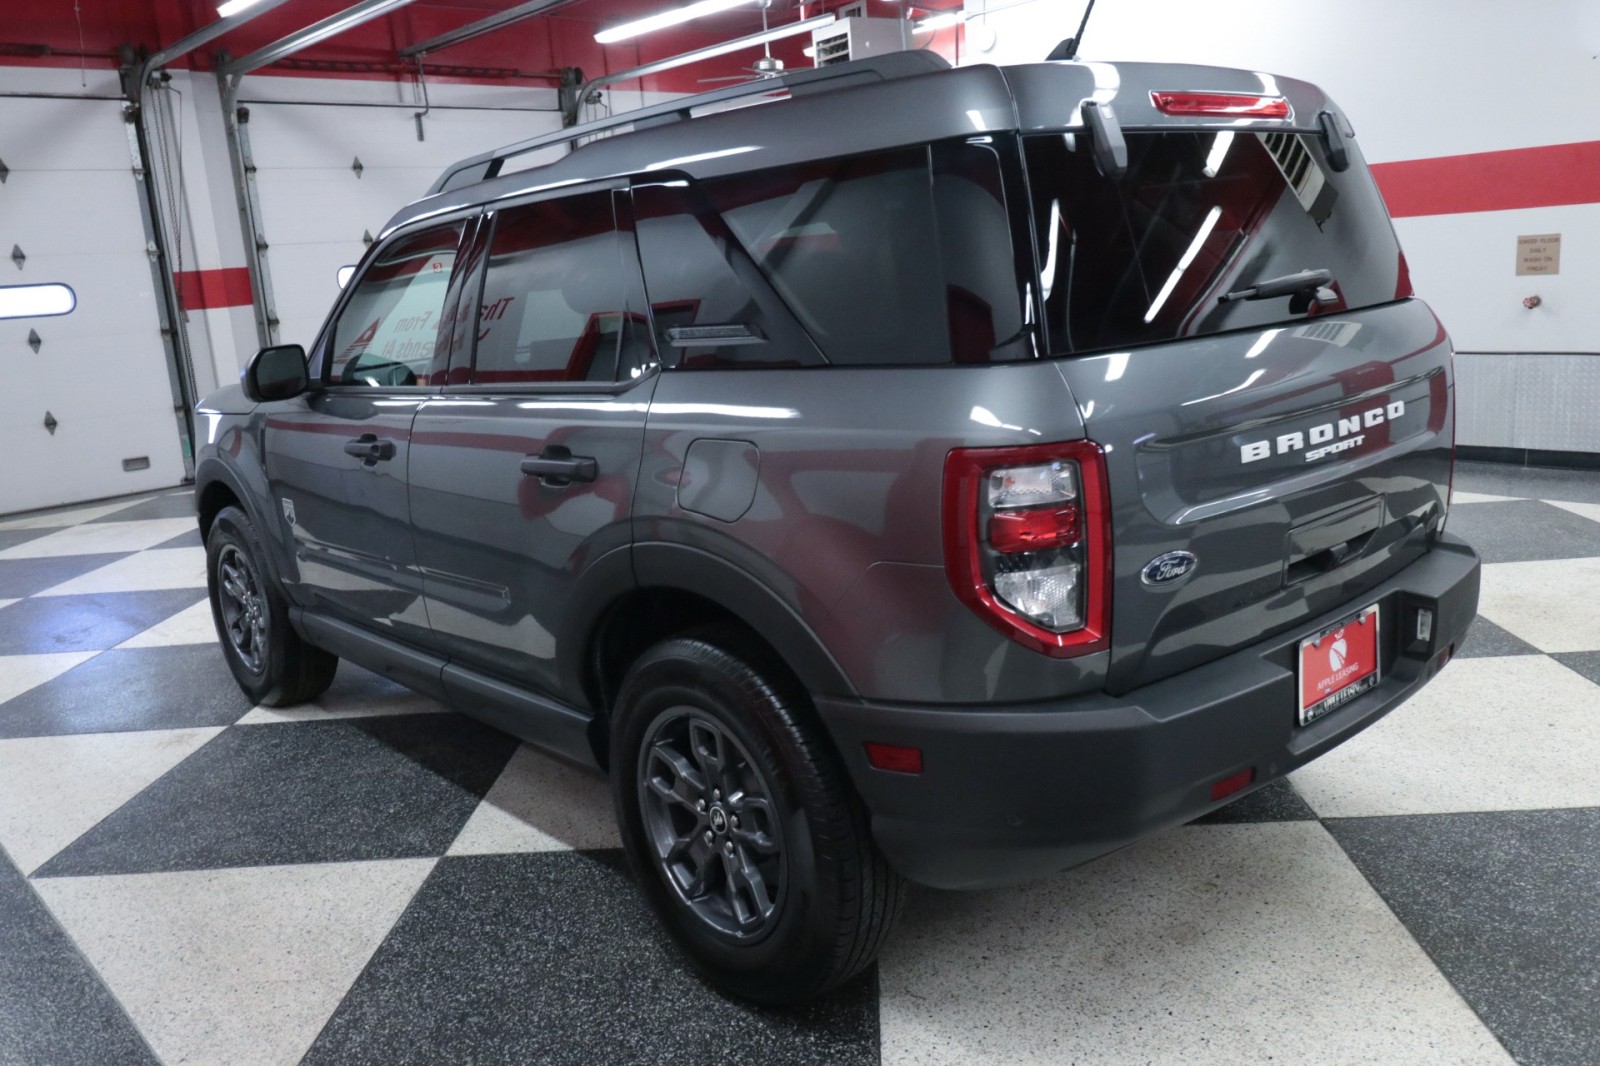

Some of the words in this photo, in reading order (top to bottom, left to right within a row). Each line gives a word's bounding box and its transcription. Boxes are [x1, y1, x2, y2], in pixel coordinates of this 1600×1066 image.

[1240, 400, 1405, 464] BRONCO
[1305, 434, 1366, 463] SPORT
[1156, 558, 1188, 581] Ford
[1317, 673, 1336, 691] APPLE
[1335, 661, 1359, 682] LEASING
